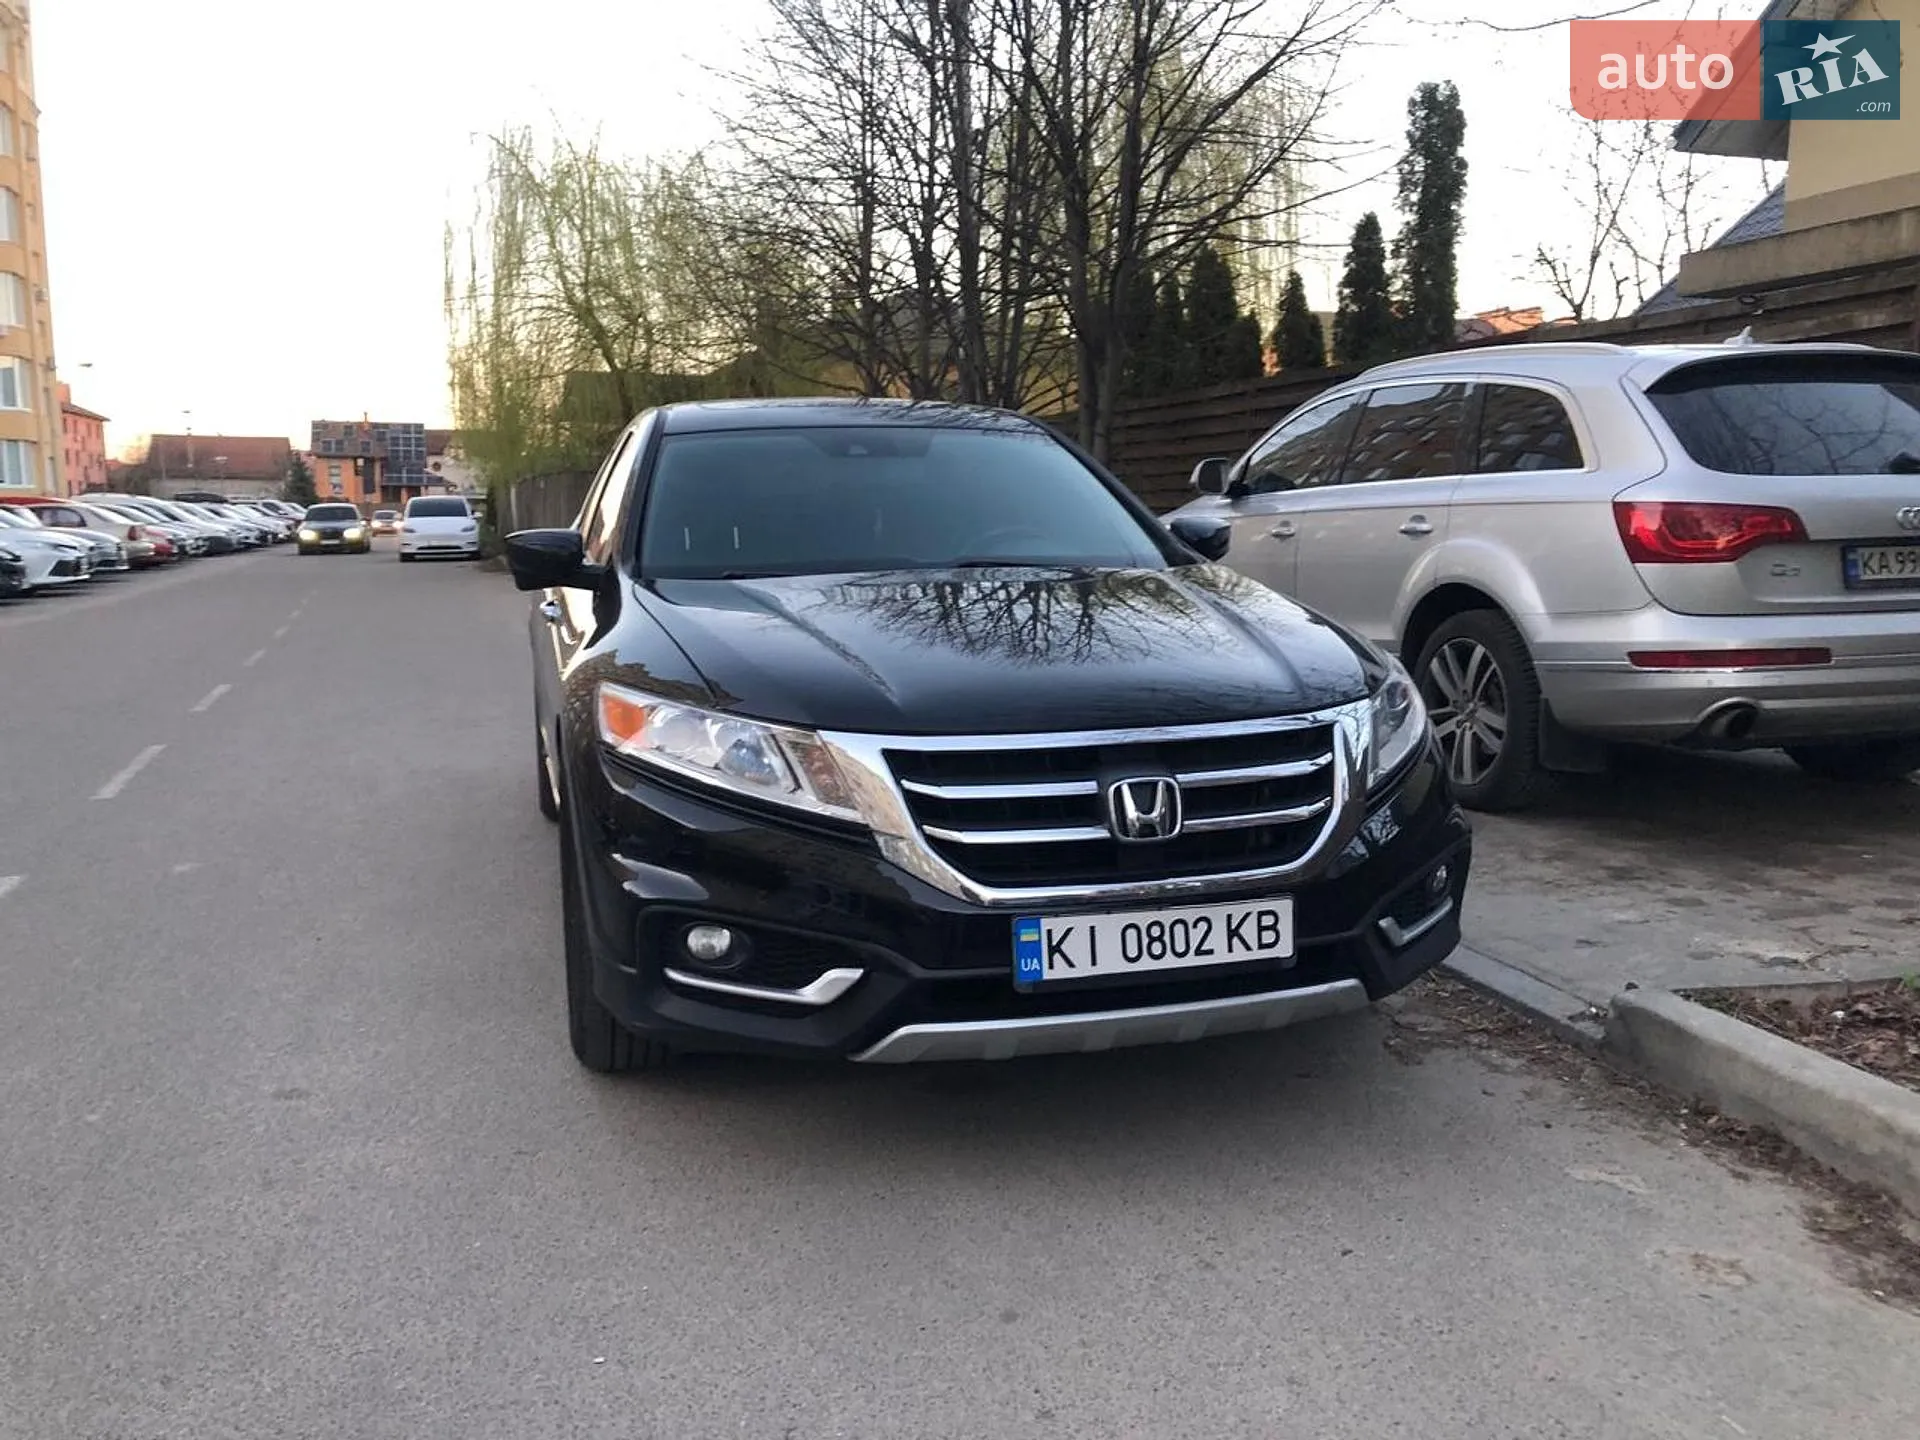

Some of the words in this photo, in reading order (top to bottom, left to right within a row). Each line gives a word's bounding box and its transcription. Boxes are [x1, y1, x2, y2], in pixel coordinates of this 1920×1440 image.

[1045, 925, 1099, 971] KI
[1120, 915, 1216, 964] 0802
[1225, 908, 1283, 954] KB
[1020, 956, 1041, 973] UA
